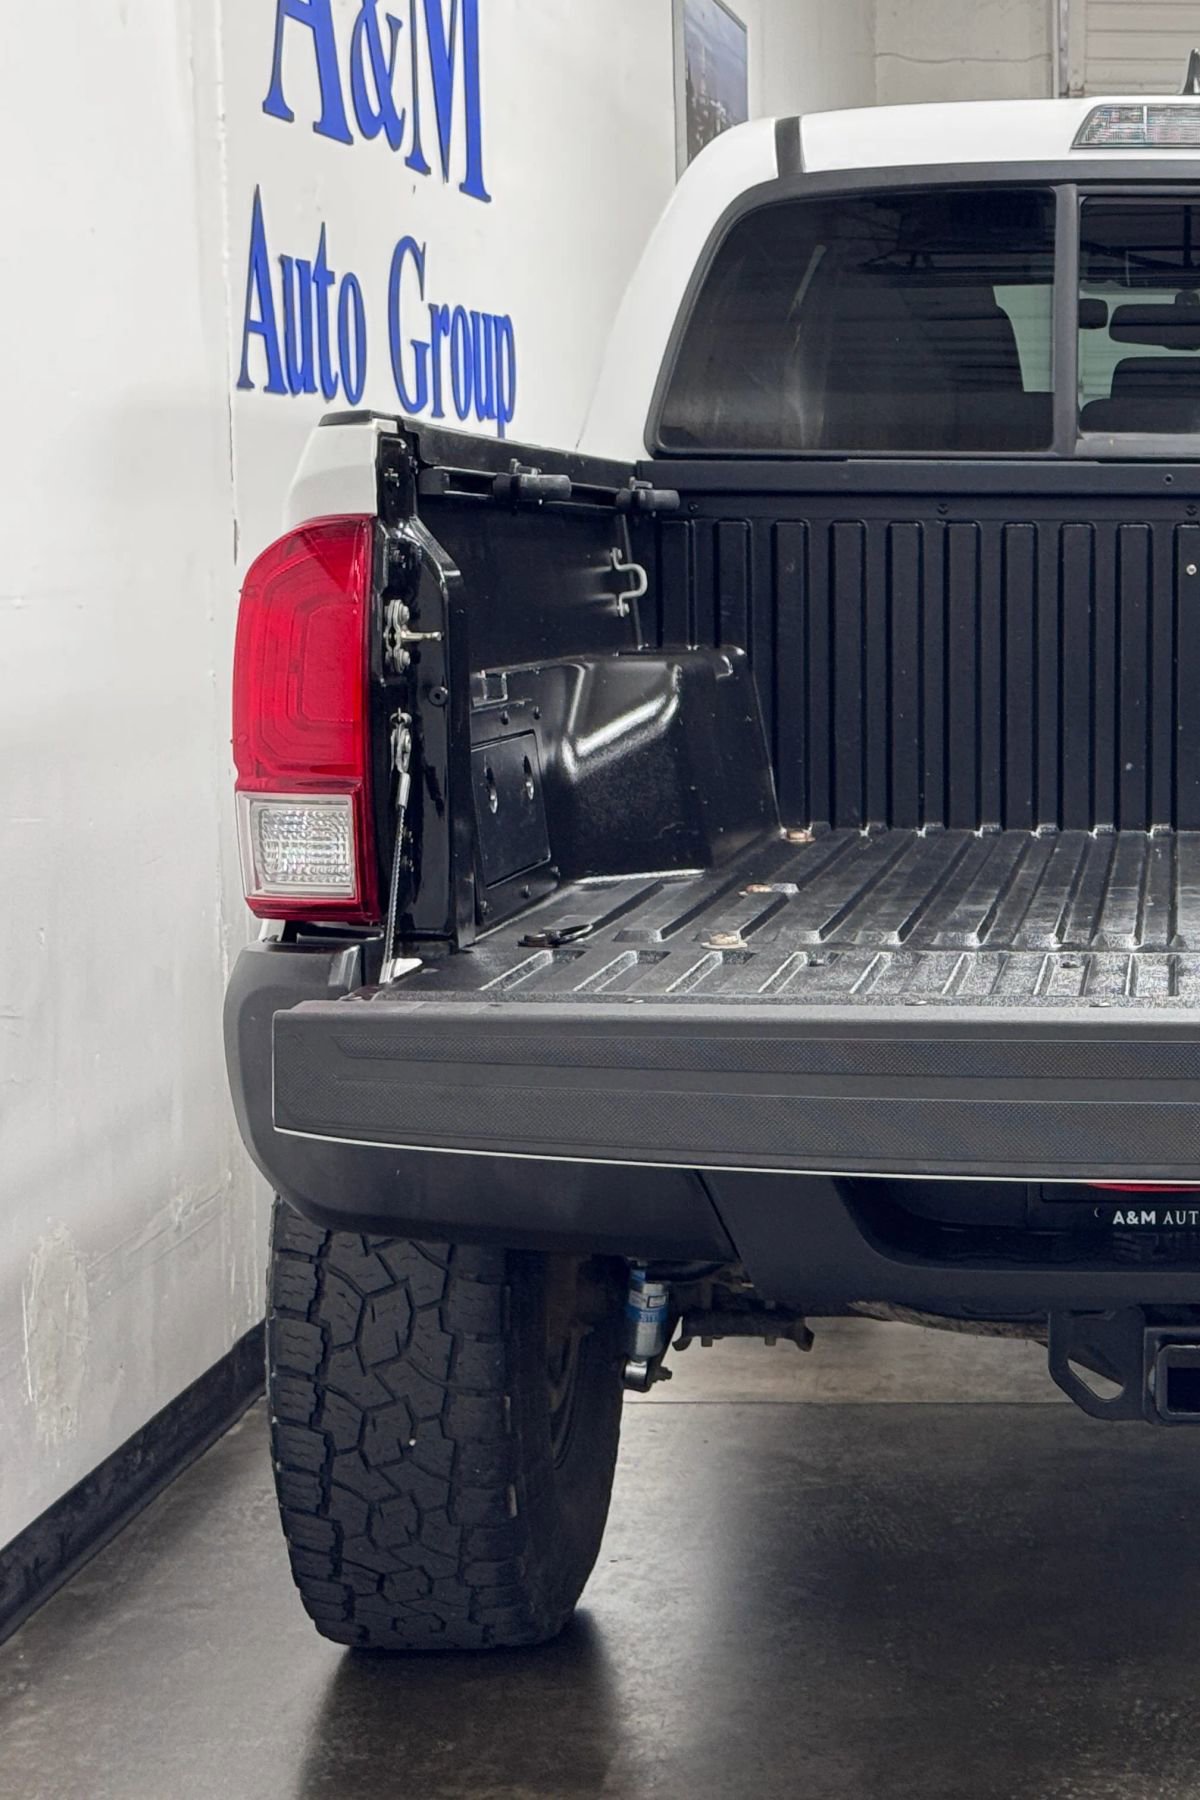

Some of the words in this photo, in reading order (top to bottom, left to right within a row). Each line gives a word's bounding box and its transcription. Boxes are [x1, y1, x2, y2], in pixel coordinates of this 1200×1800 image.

[237, 184, 367, 405] Auto
[388, 235, 516, 439] Group
[1112, 1210, 1156, 1225] A&M
